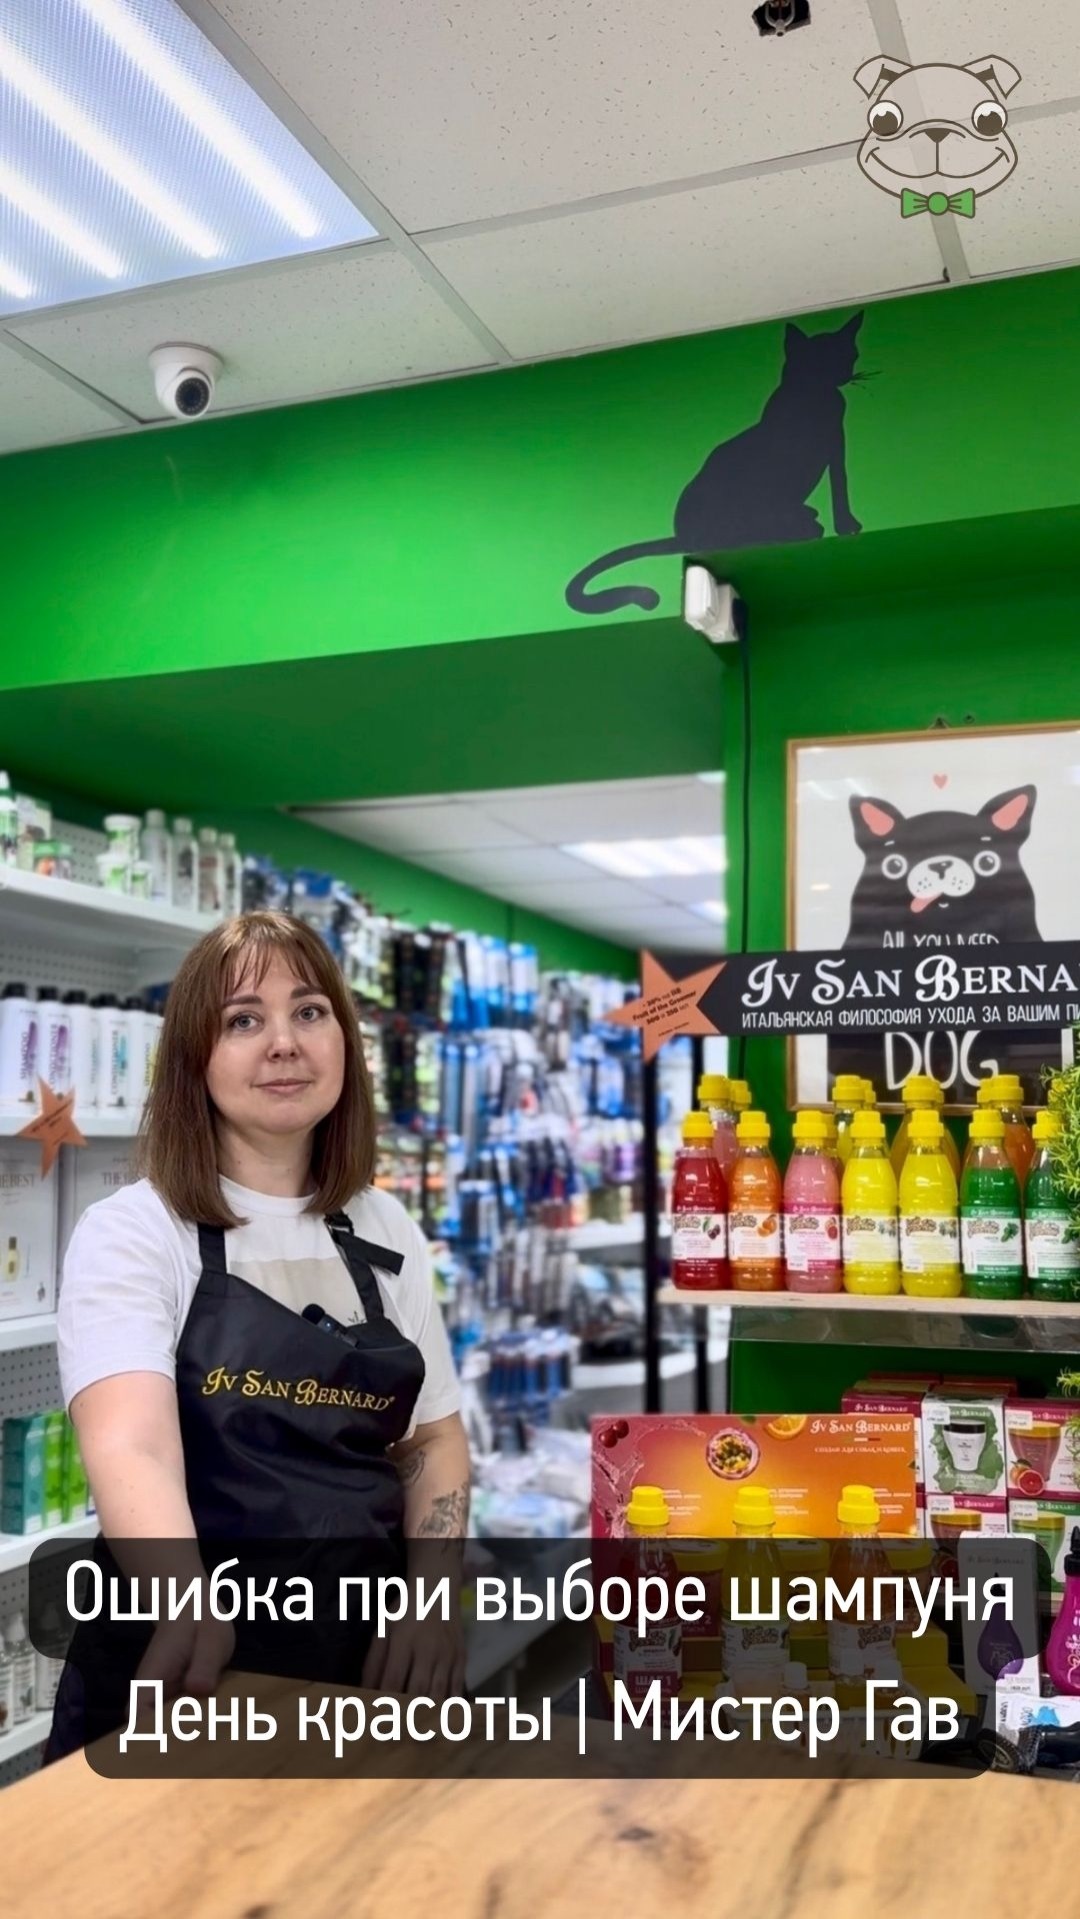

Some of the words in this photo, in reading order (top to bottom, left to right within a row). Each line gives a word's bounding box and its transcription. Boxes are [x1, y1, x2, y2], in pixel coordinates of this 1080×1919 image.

[811, 959, 903, 1005] SAN
[915, 954, 1080, 1002] BERNA
[742, 1010, 833, 1028] ИТАЛЬЯНСКАЯ
[839, 1007, 922, 1026] ФИЛОСОФИЯ
[927, 1006, 976, 1025] УХОДА
[982, 1005, 1001, 1023] ЗА
[1007, 1004, 1060, 1022] ВАШИМ
[885, 1031, 999, 1090] DOG
[242, 1370, 291, 1398] SAN
[829, 1420, 853, 1433] SAN
